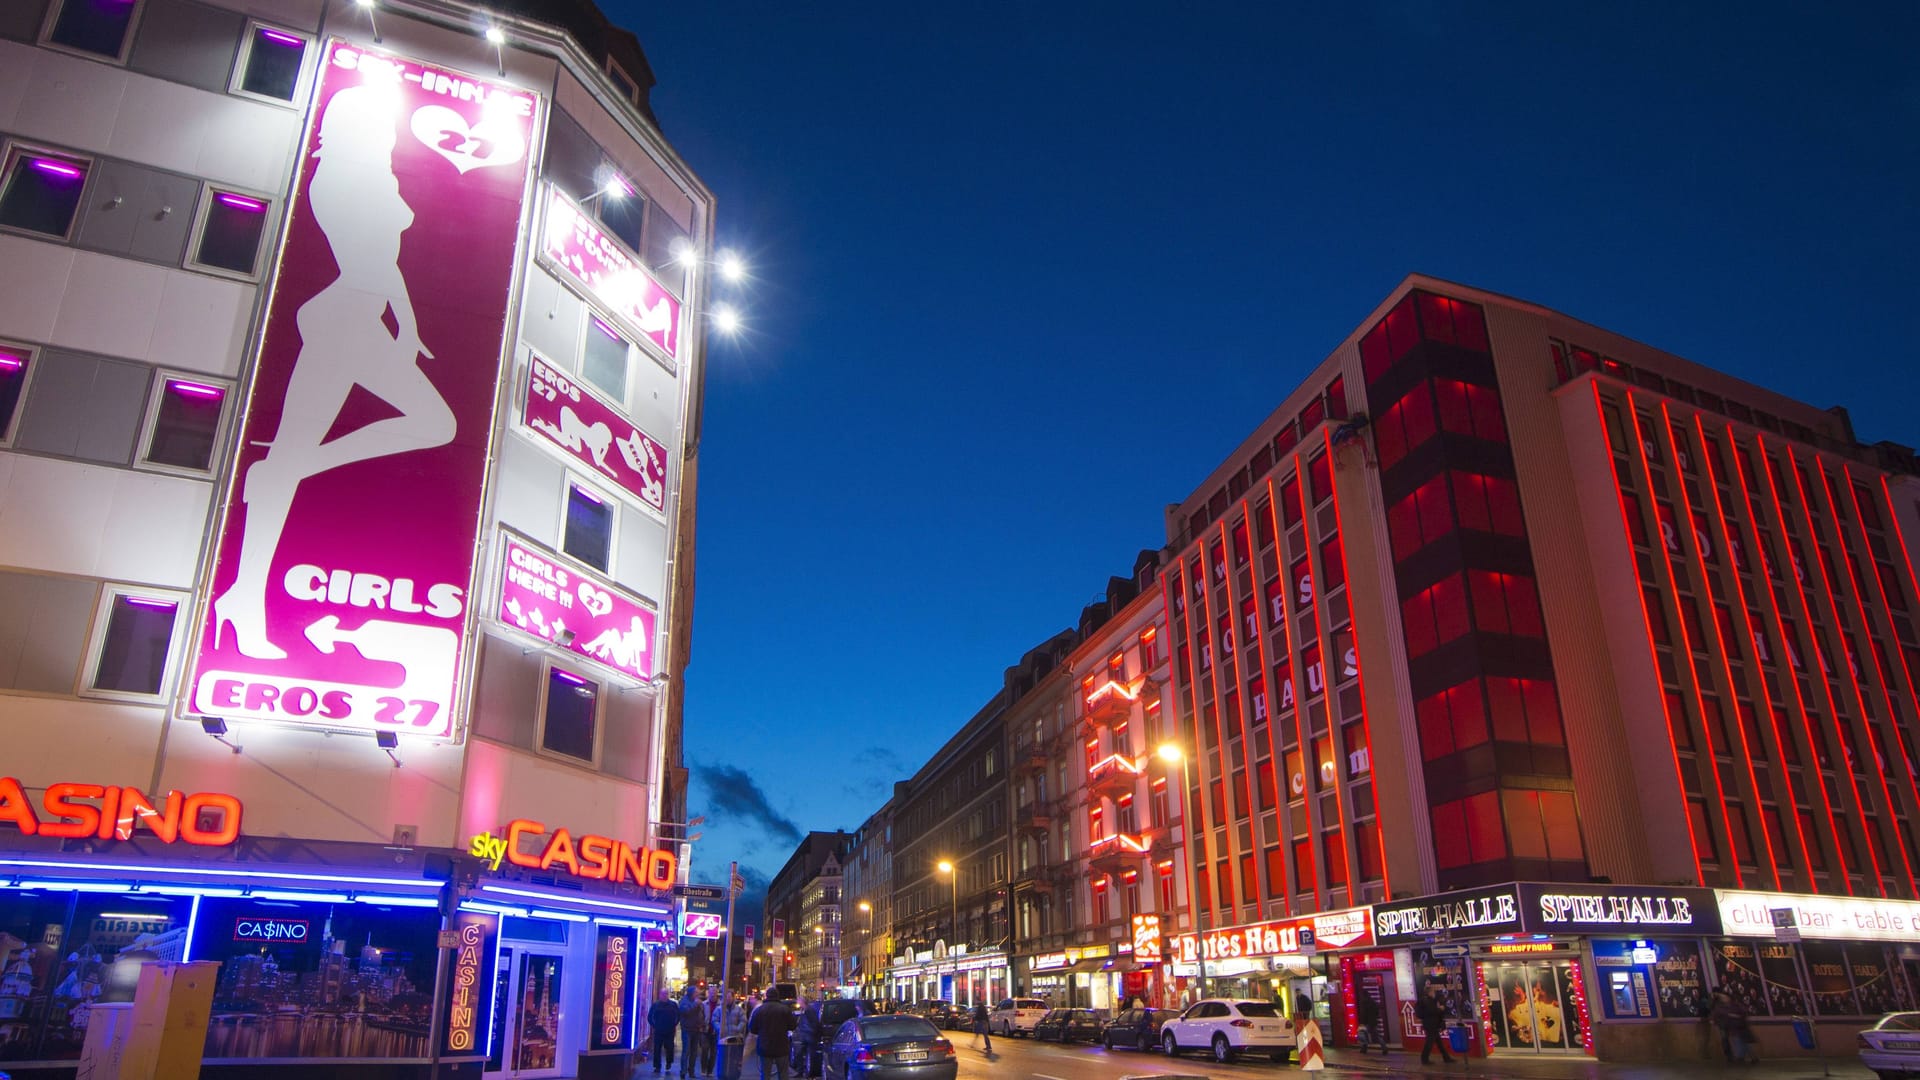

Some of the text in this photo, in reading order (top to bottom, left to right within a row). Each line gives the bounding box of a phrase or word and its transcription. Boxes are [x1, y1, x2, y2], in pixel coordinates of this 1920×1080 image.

[437, 129, 495, 159] 27
[532, 377, 557, 401] 27
[534, 360, 580, 402] EROS
[629, 443, 645, 473] EROS
[643, 438, 664, 476] GIRLS
[508, 565, 557, 601] HERE
[510, 548, 568, 588] GIRLS
[284, 564, 463, 618] GIRLS
[586, 595, 604, 610] 27
[1202, 574, 1313, 669] ROTES
[211, 679, 440, 727] EROS 27
[1255, 648, 1359, 722] HAUS
[470, 819, 676, 891] sky CASINO
[683, 887, 713, 897] Elbestraße
[1540, 894, 1693, 925] SPIELHALLE
[238, 921, 306, 940] CA$INO
[1376, 894, 1517, 937] SPIELHALLE
[1797, 906, 1834, 928] bar
[1854, 909, 1904, 930] table
[1134, 925, 1160, 949] Eros
[1183, 932, 1241, 962] Rotes
[1302, 931, 1312, 944] P
[450, 924, 480, 1050] CASINO
[606, 937, 625, 1043] CASINO
